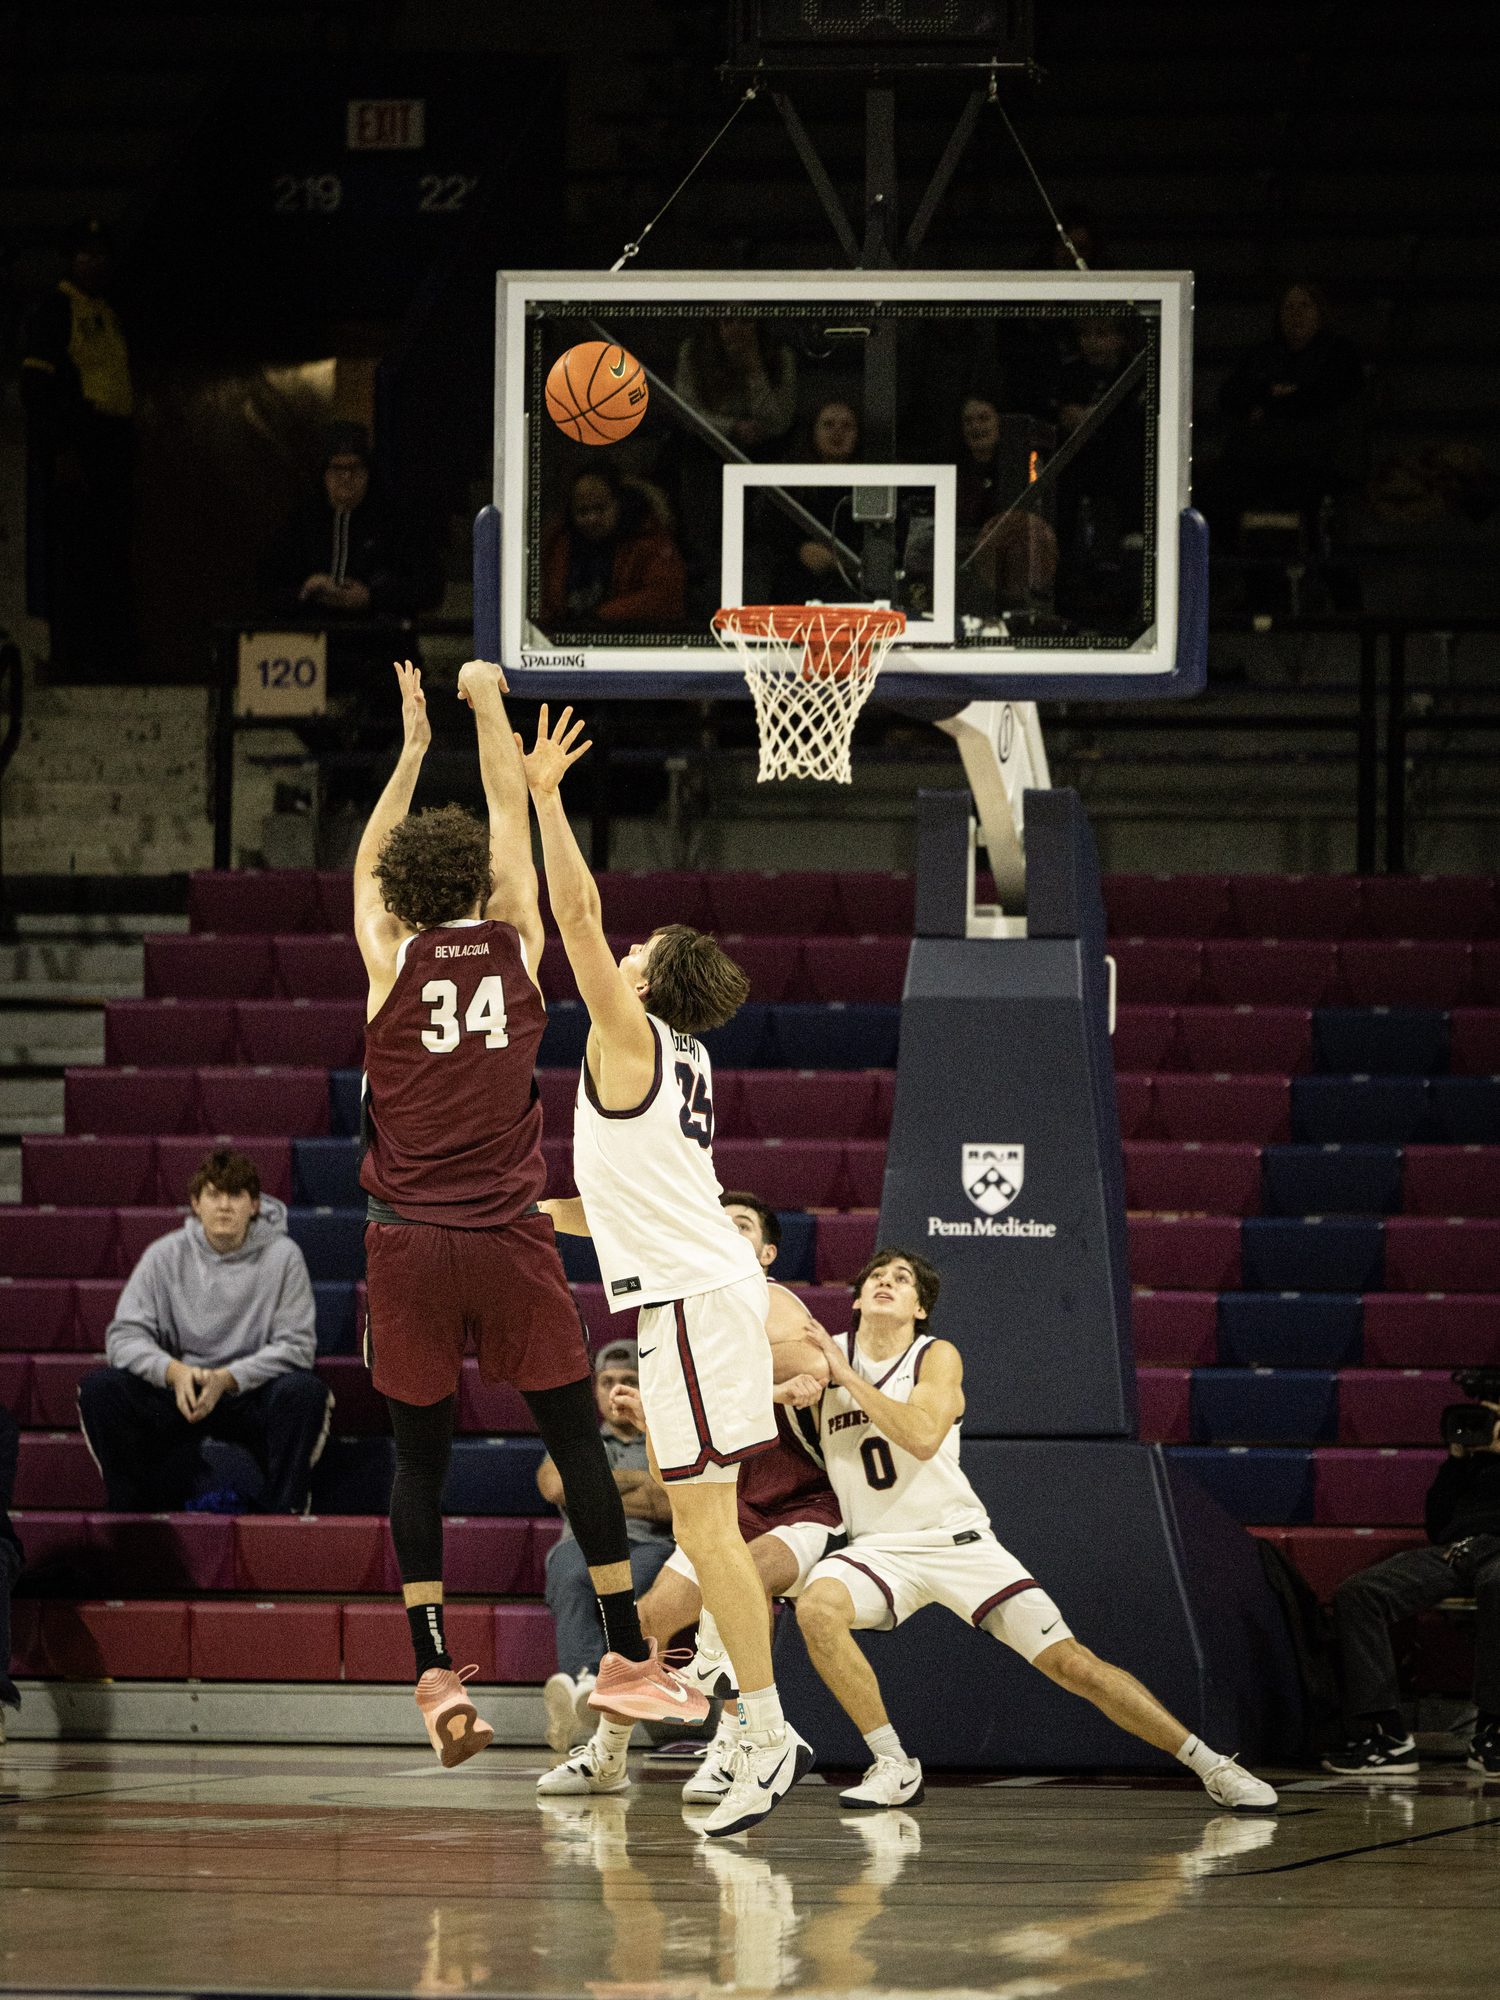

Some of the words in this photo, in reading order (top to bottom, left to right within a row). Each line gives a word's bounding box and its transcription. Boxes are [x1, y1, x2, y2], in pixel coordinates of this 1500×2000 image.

[357, 104, 411, 146] EXIT
[273, 175, 343, 213] 219
[258, 657, 316, 688] 120
[521, 653, 585, 668] SPALDING
[435, 943, 490, 958] BEVILACQUA
[421, 975, 509, 1053] 34
[927, 1216, 973, 1236] Penn
[974, 1216, 1057, 1237] Medicine
[827, 1409, 872, 1435] PENNS
[860, 1436, 898, 1491] 0
